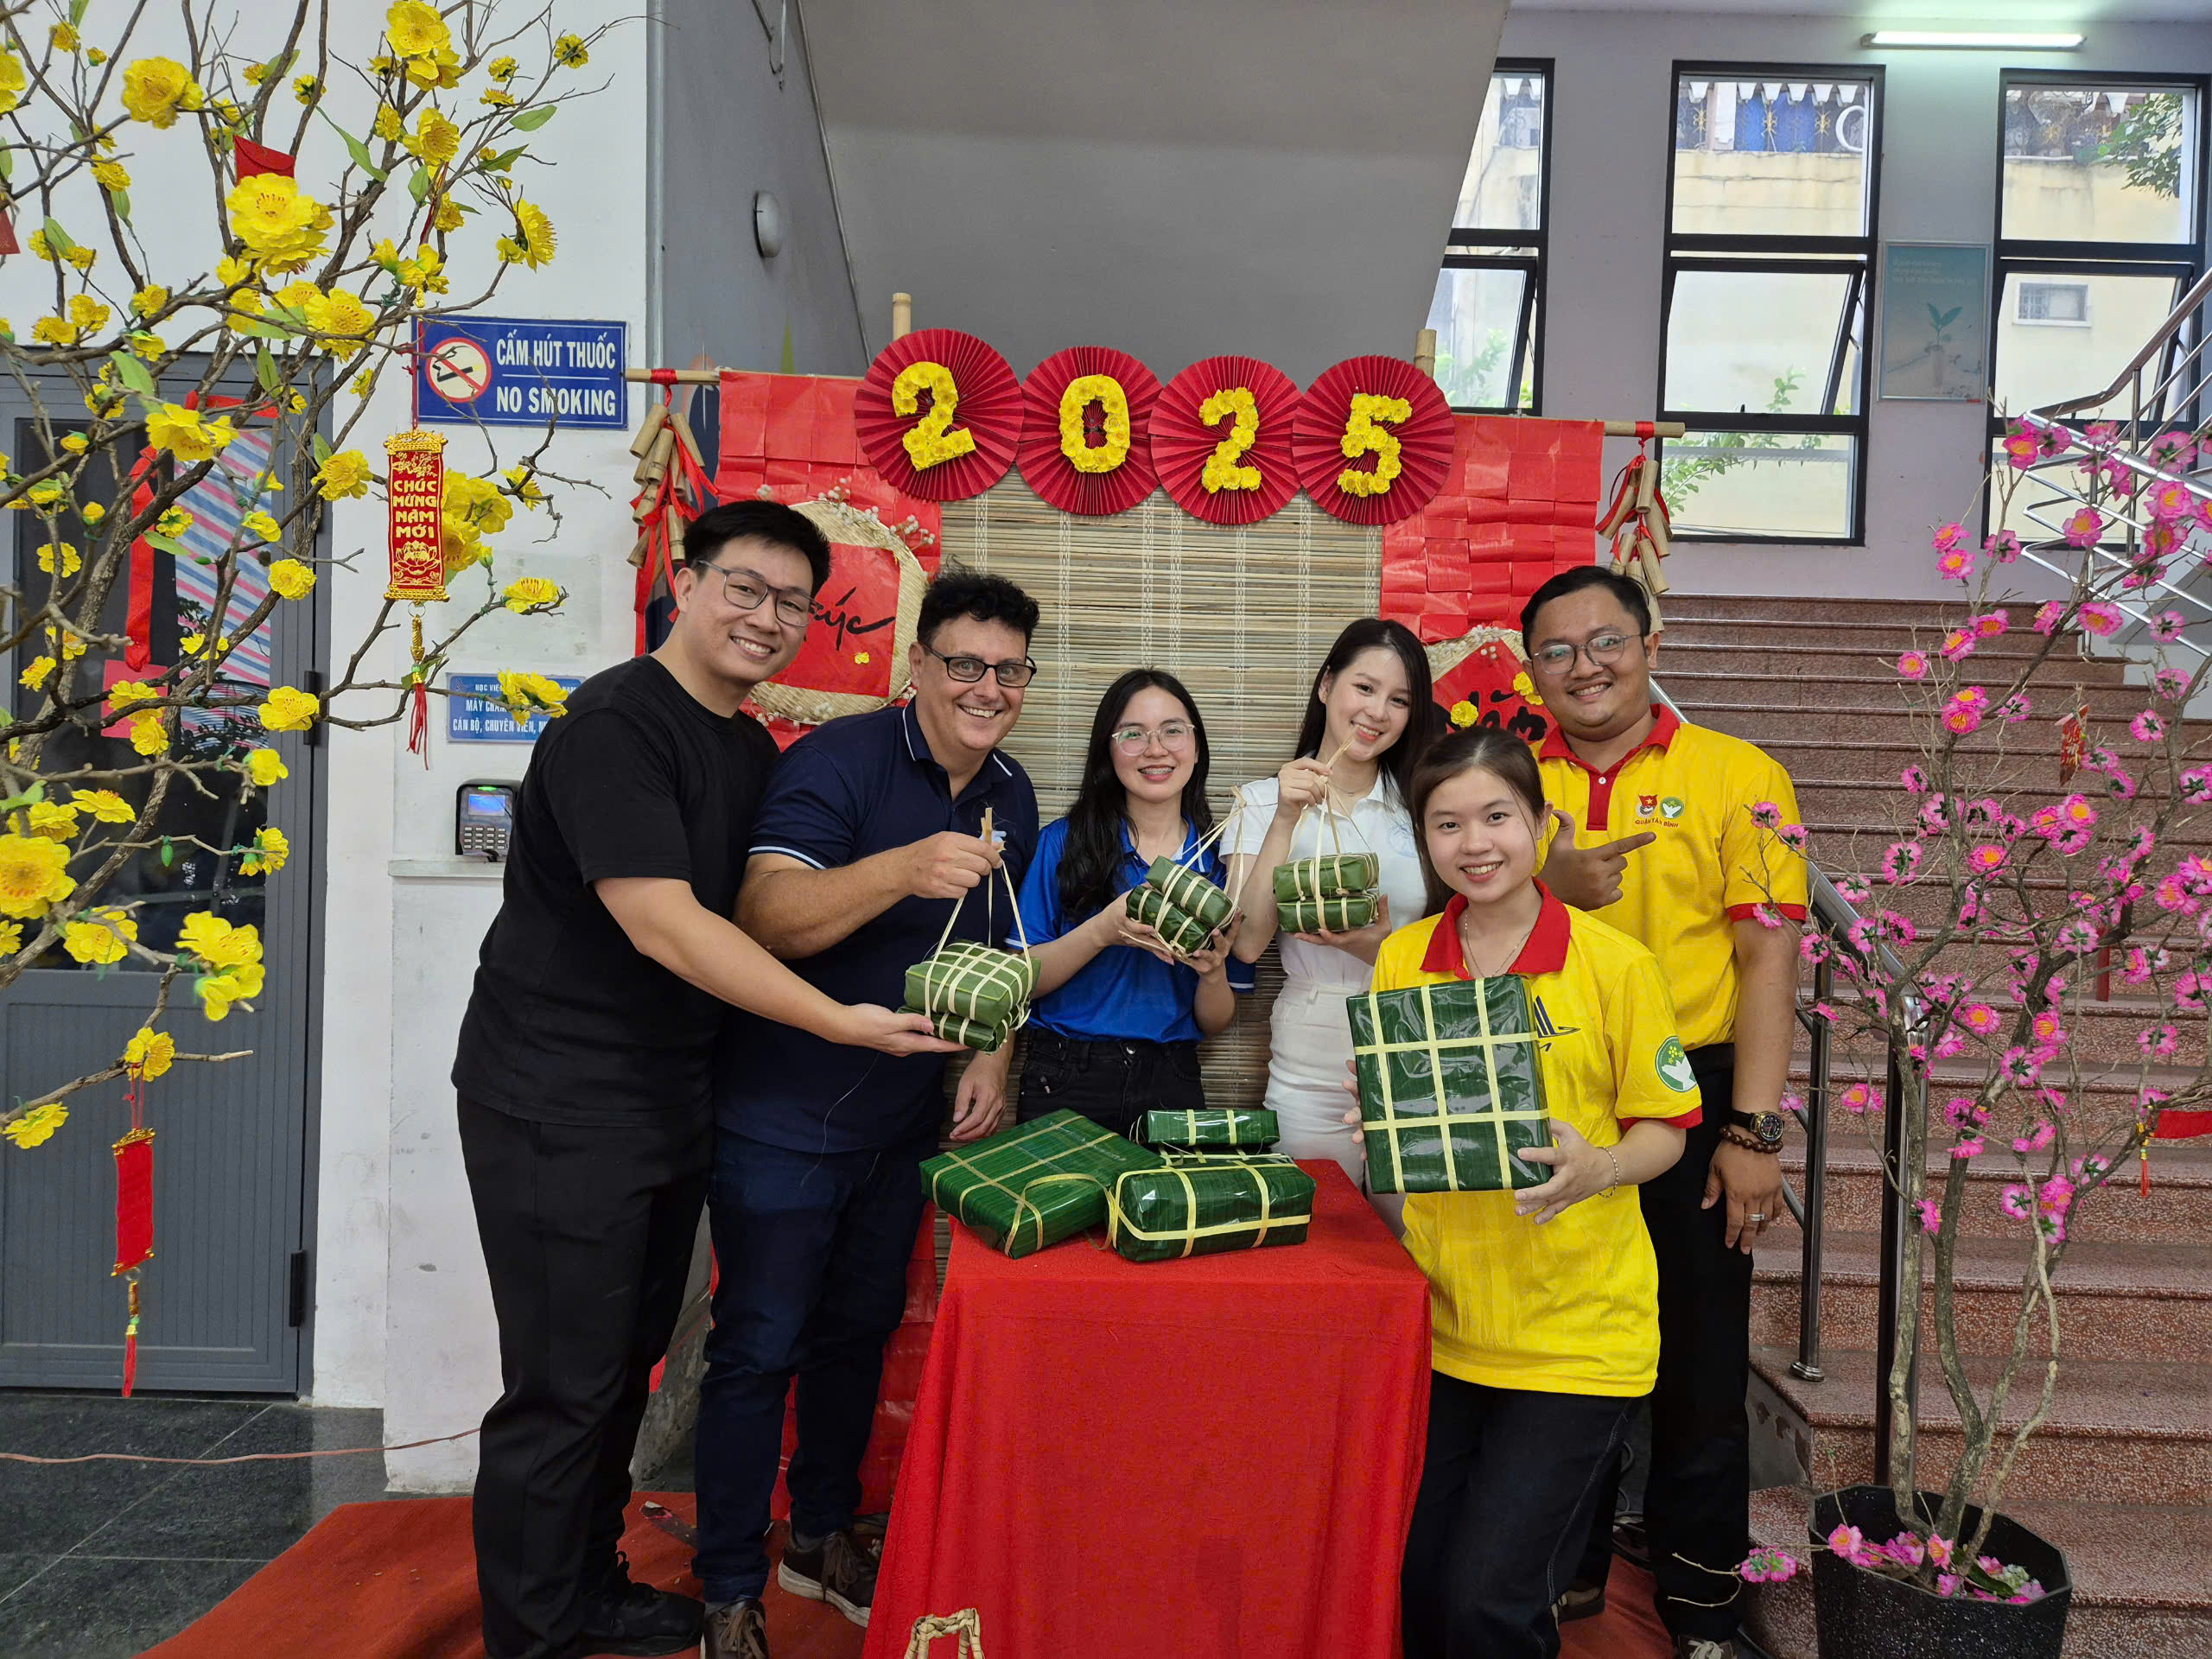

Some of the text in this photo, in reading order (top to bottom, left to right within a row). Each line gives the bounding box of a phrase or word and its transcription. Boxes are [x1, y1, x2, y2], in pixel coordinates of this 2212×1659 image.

[496, 329, 616, 369] CẤM HÚT THUỐC
[496, 386, 616, 416] NO SMOKING
[892, 361, 1412, 497] 2025
[393, 478, 437, 493] CHÚC
[392, 493, 437, 507] MỪNG
[395, 509, 435, 524] NĂM
[396, 524, 435, 538] MỚI
